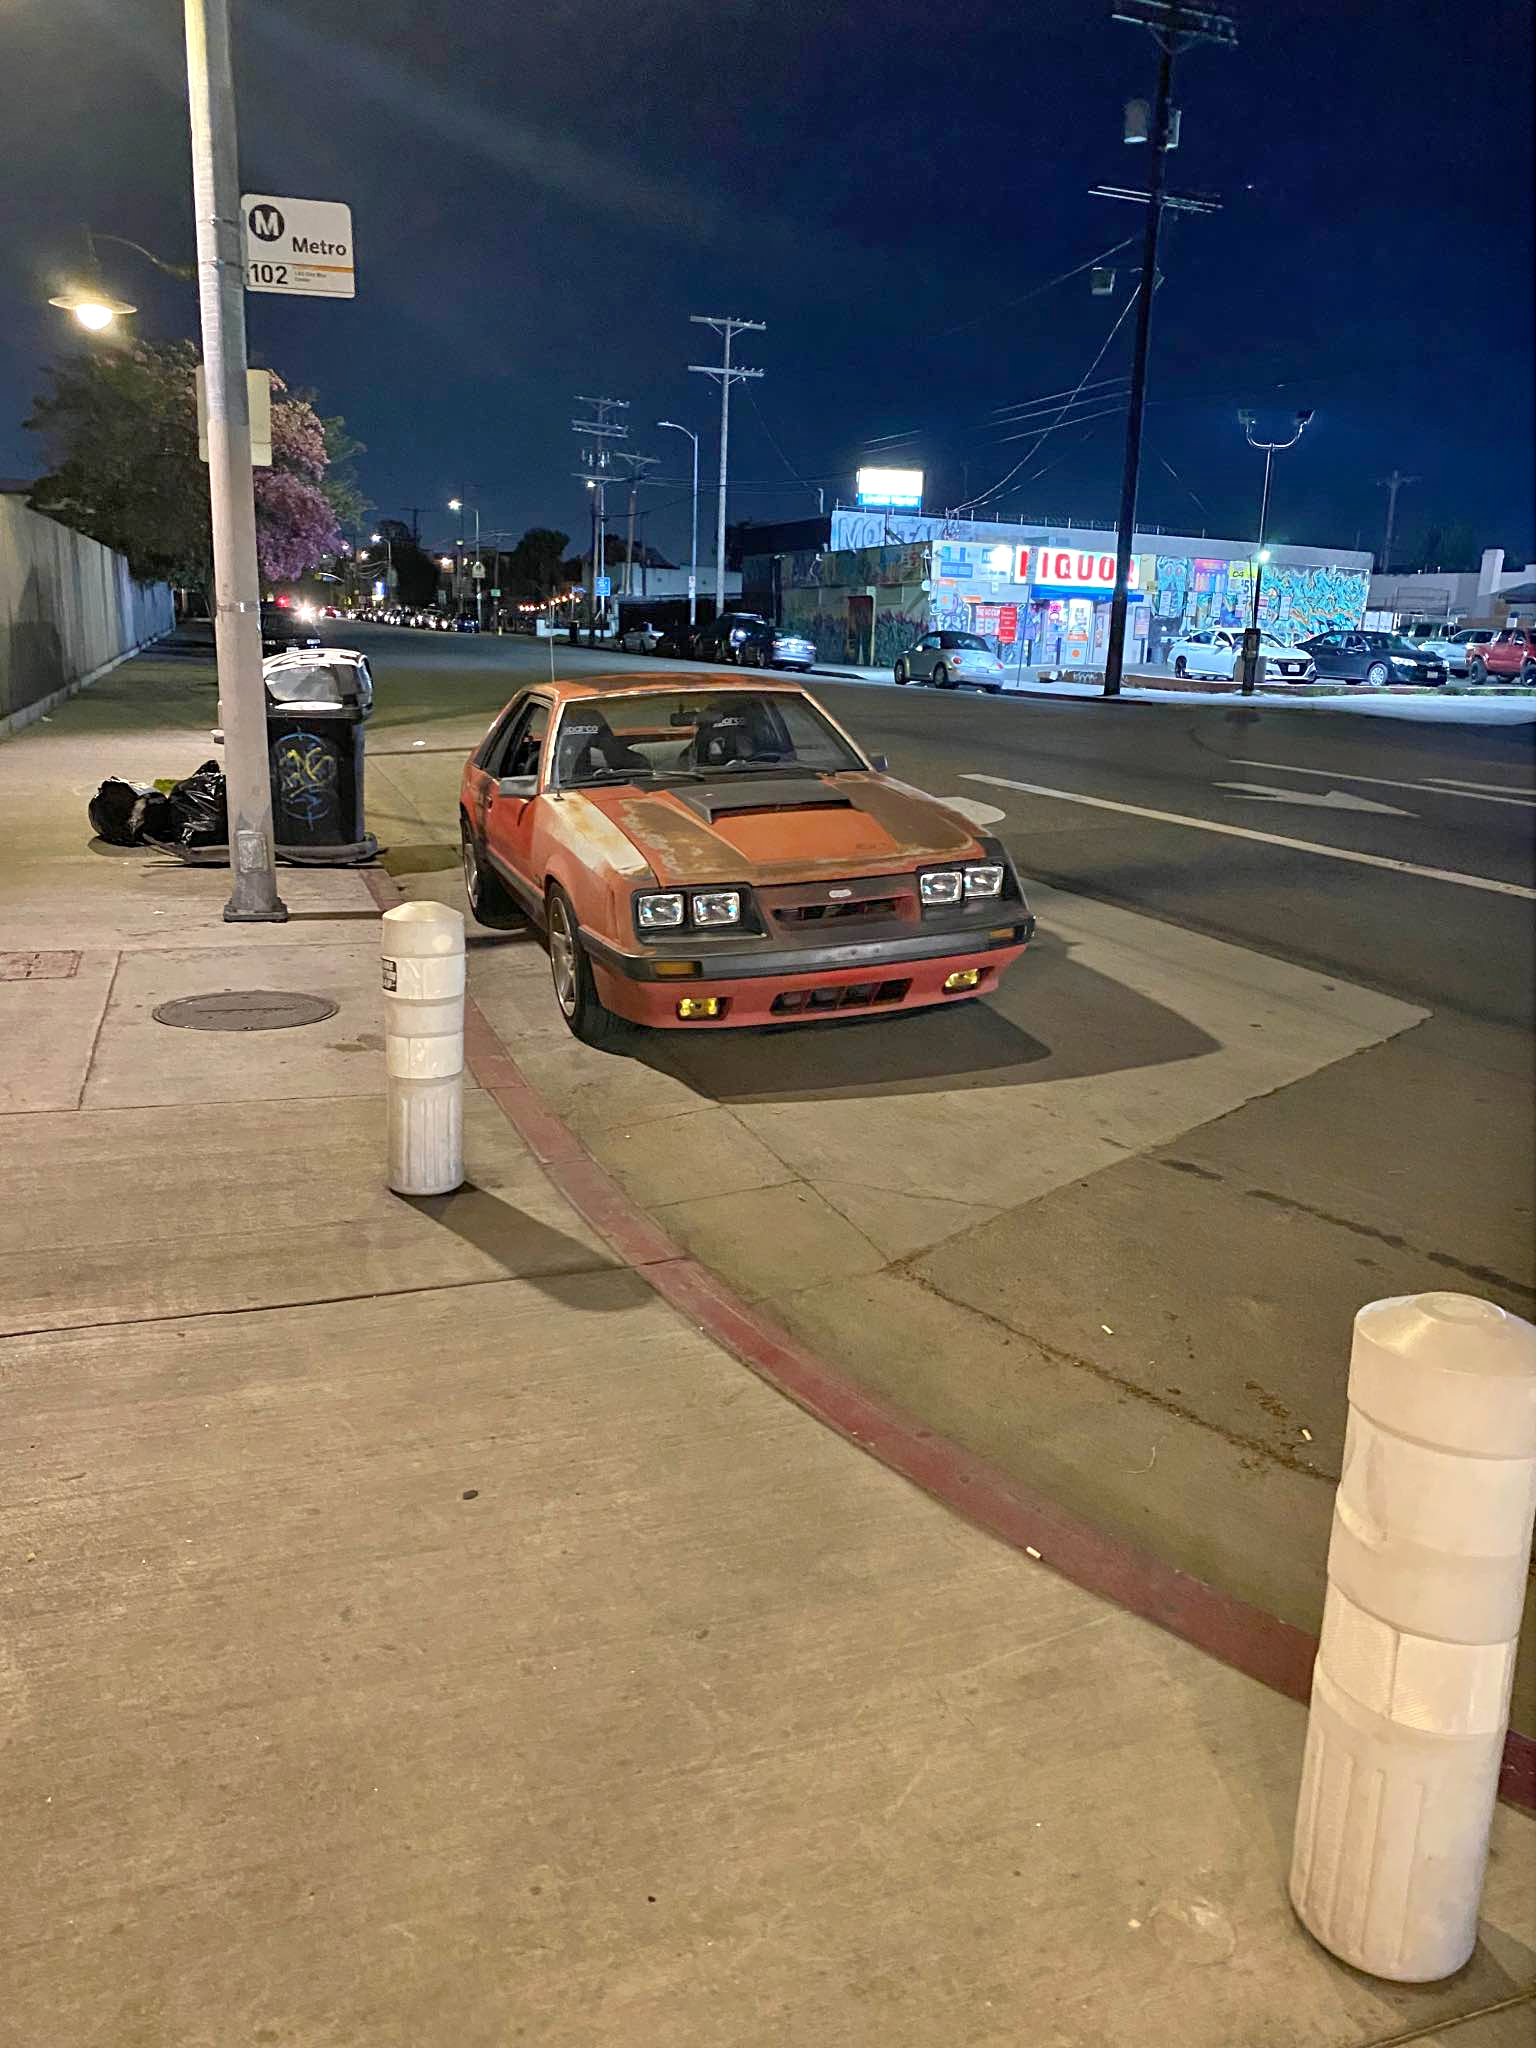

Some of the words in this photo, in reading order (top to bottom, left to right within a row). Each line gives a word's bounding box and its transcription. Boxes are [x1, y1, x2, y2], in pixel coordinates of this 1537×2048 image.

[254, 209, 280, 236] M
[292, 236, 347, 256] Metro
[249, 263, 289, 285] 102
